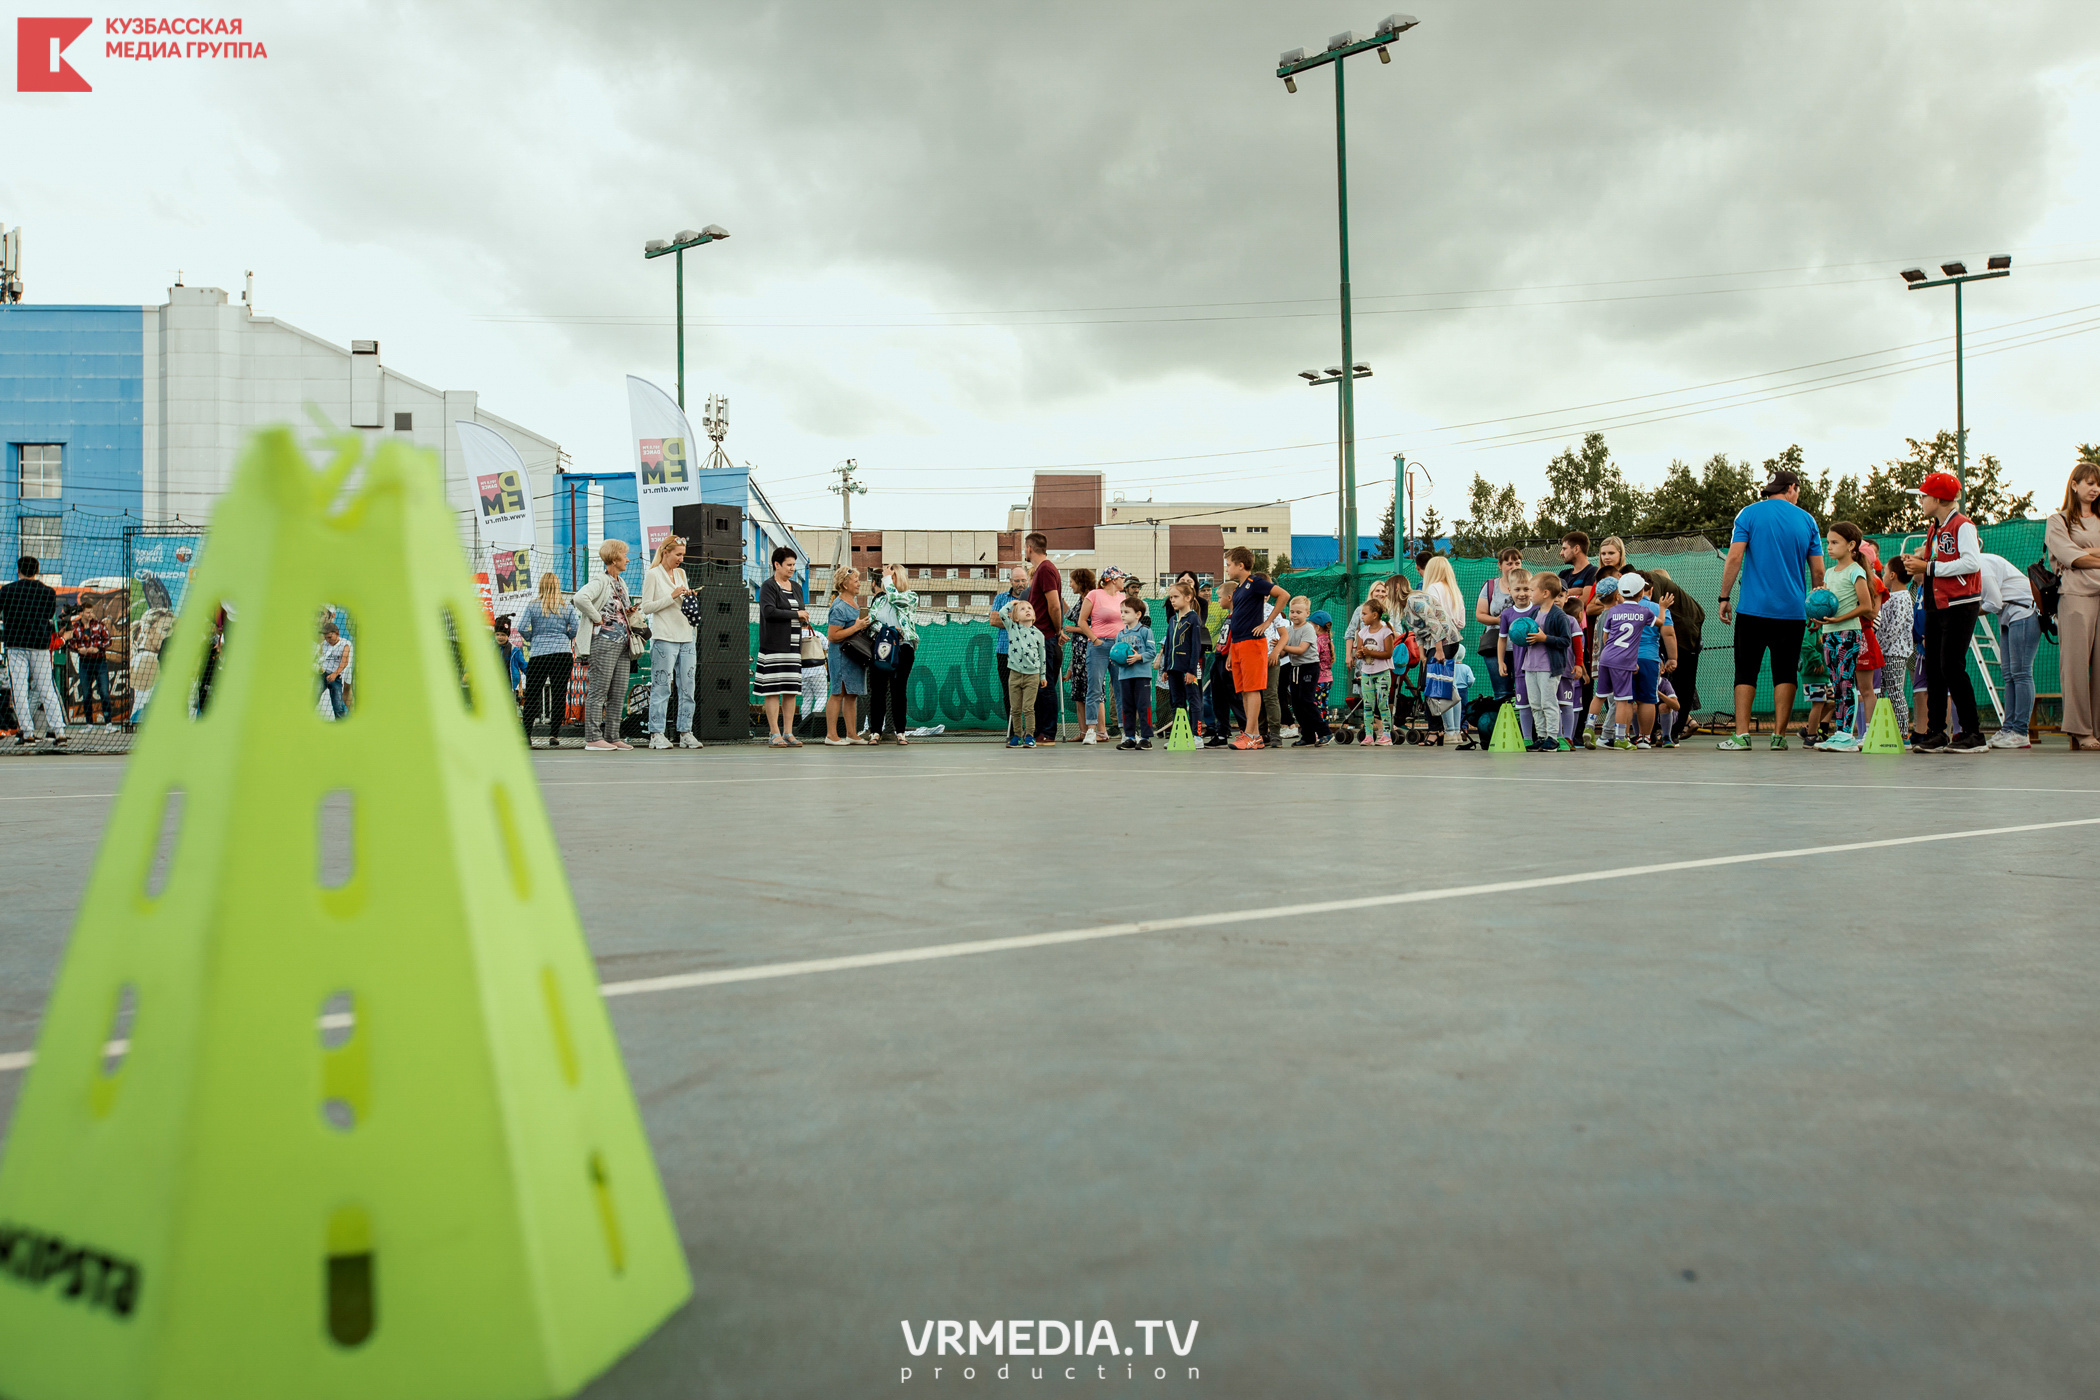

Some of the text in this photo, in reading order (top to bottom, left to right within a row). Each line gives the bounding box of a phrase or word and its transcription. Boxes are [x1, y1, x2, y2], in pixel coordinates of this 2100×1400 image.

[1612, 613, 1645, 621] ШИРШОВ
[1613, 622, 1634, 649] 2
[1563, 690, 1573, 700] 10
